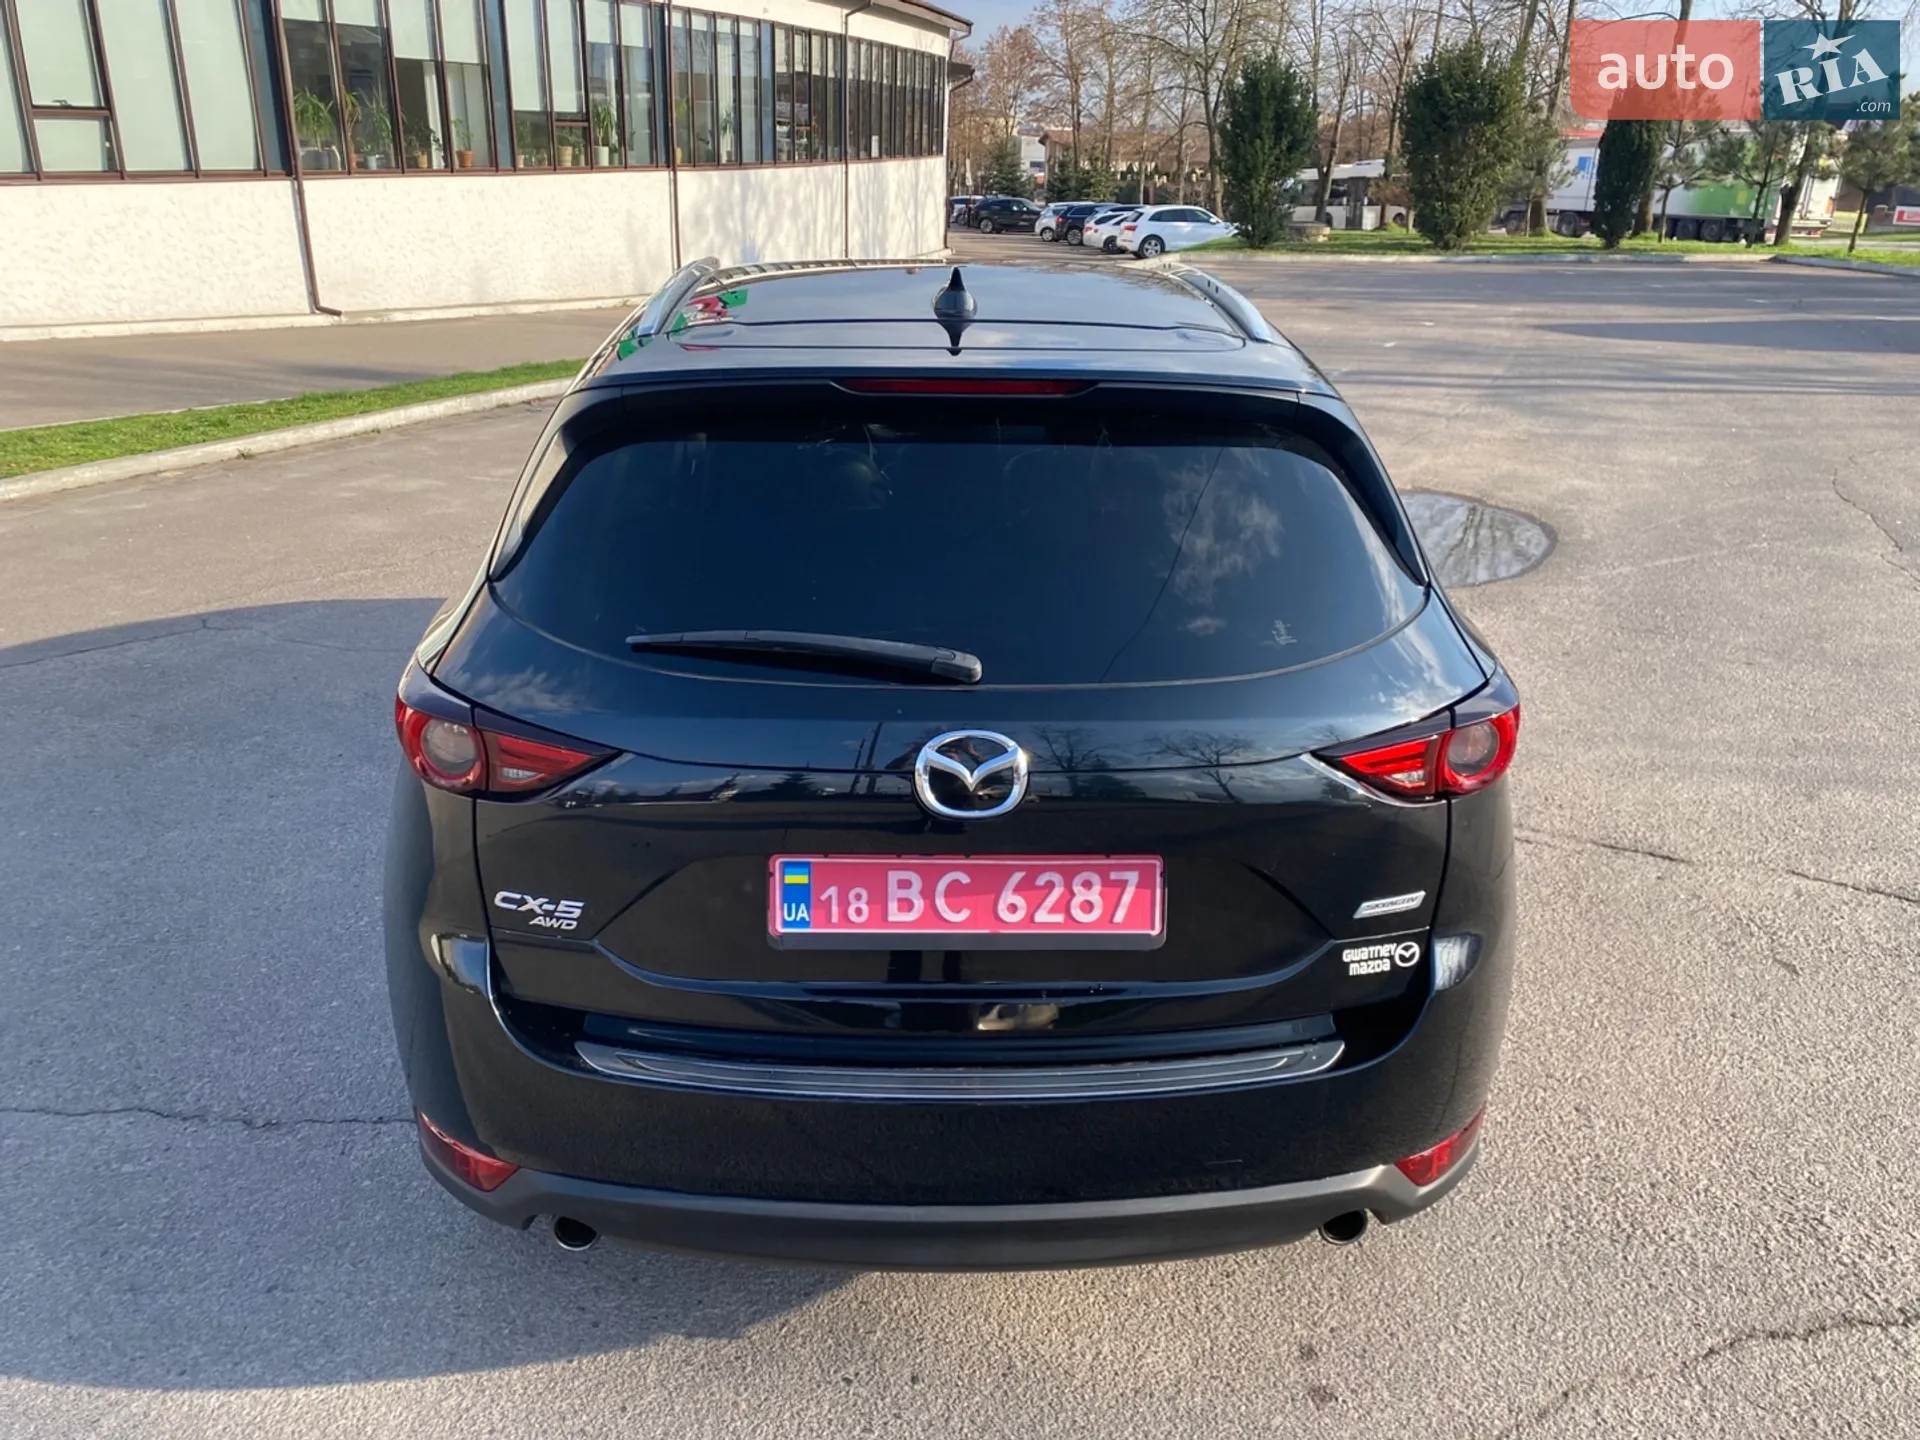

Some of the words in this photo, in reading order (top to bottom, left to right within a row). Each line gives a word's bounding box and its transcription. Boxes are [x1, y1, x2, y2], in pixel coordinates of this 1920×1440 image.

[493, 890, 585, 919] CX-5
[819, 885, 869, 924] 18
[886, 870, 972, 923] BC
[996, 870, 1141, 924] 6287
[528, 916, 578, 931] AWD
[783, 903, 810, 922] UA
